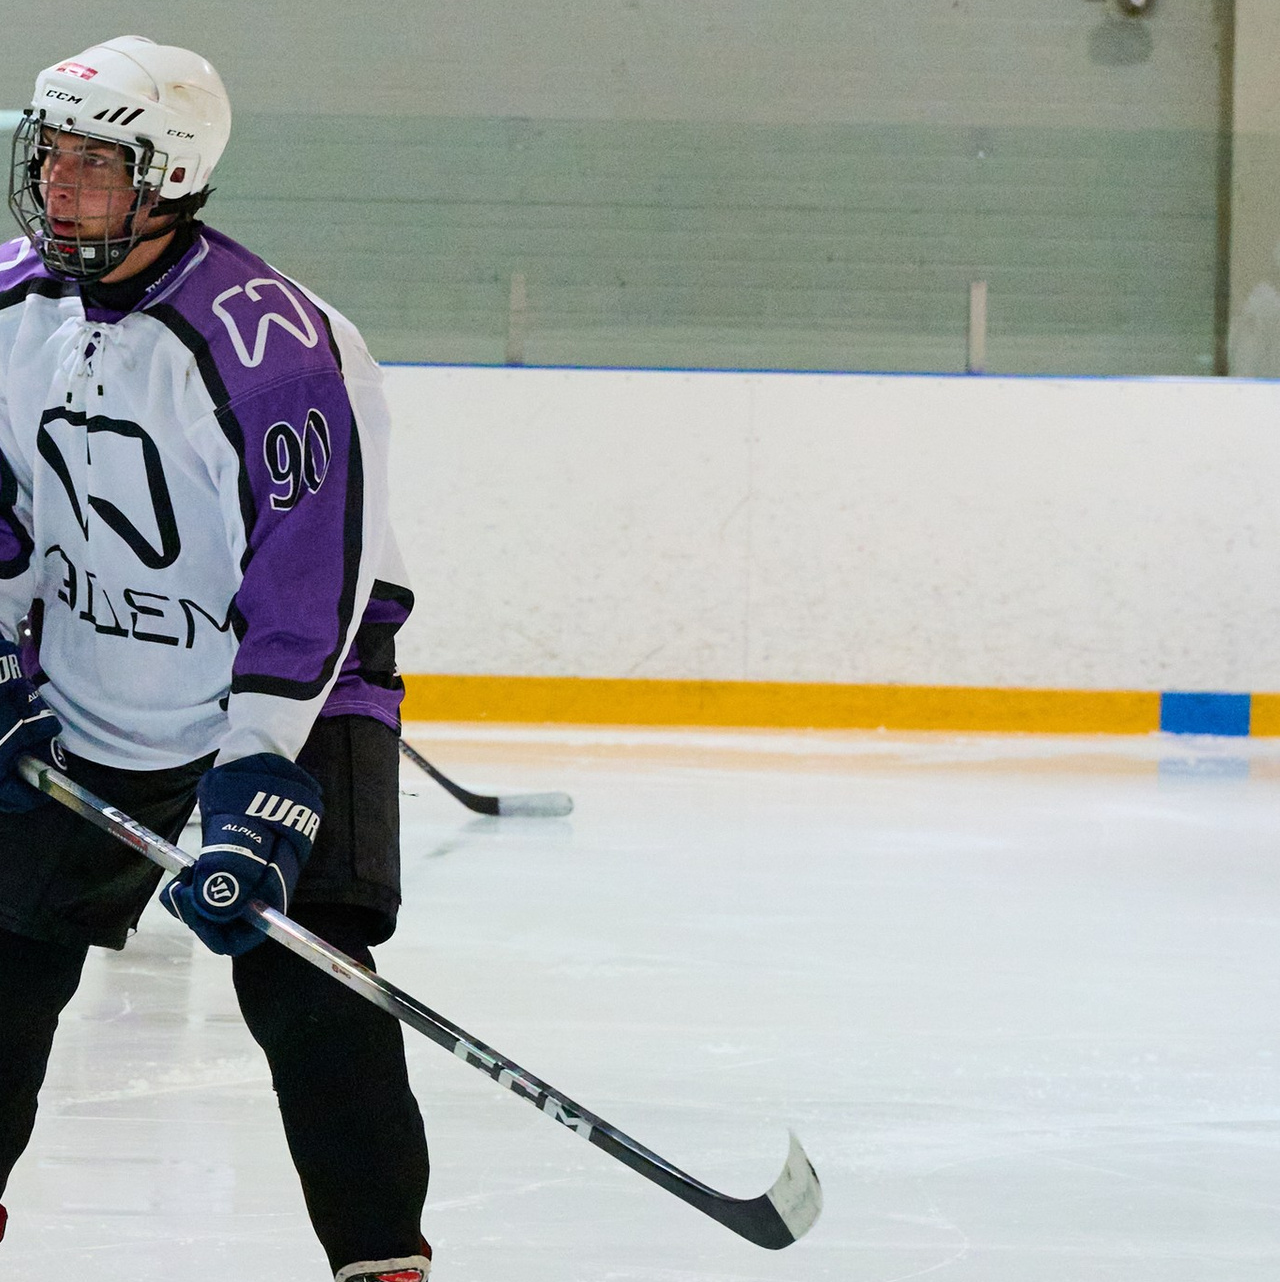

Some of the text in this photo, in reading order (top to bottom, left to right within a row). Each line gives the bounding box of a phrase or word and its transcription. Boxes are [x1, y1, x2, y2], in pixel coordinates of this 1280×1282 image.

[46, 89, 83, 105] CCM
[166, 129, 195, 140] CCM
[263, 408, 332, 511] 90
[221, 823, 263, 844] ALPHA
[454, 1039, 596, 1141] CCM
